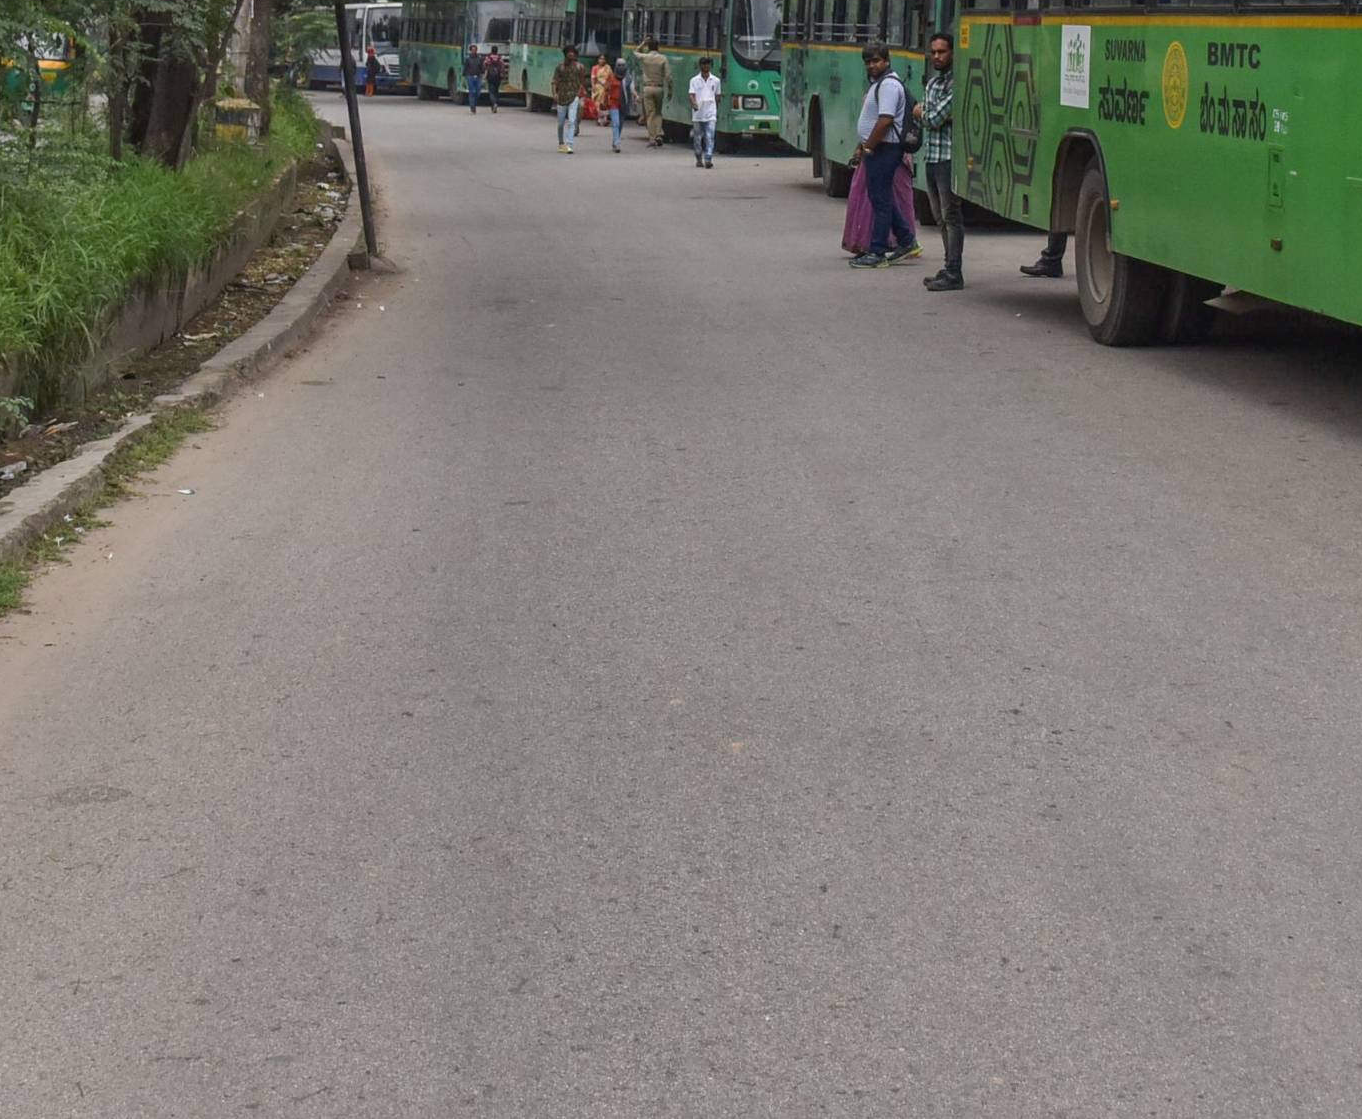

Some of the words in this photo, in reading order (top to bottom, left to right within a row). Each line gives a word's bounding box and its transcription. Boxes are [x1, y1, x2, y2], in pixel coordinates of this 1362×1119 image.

[1105, 39, 1146, 62] SUVARNA
[1207, 42, 1261, 69] BMTC
[1098, 75, 1150, 125] ಸುವರ್ಣ
